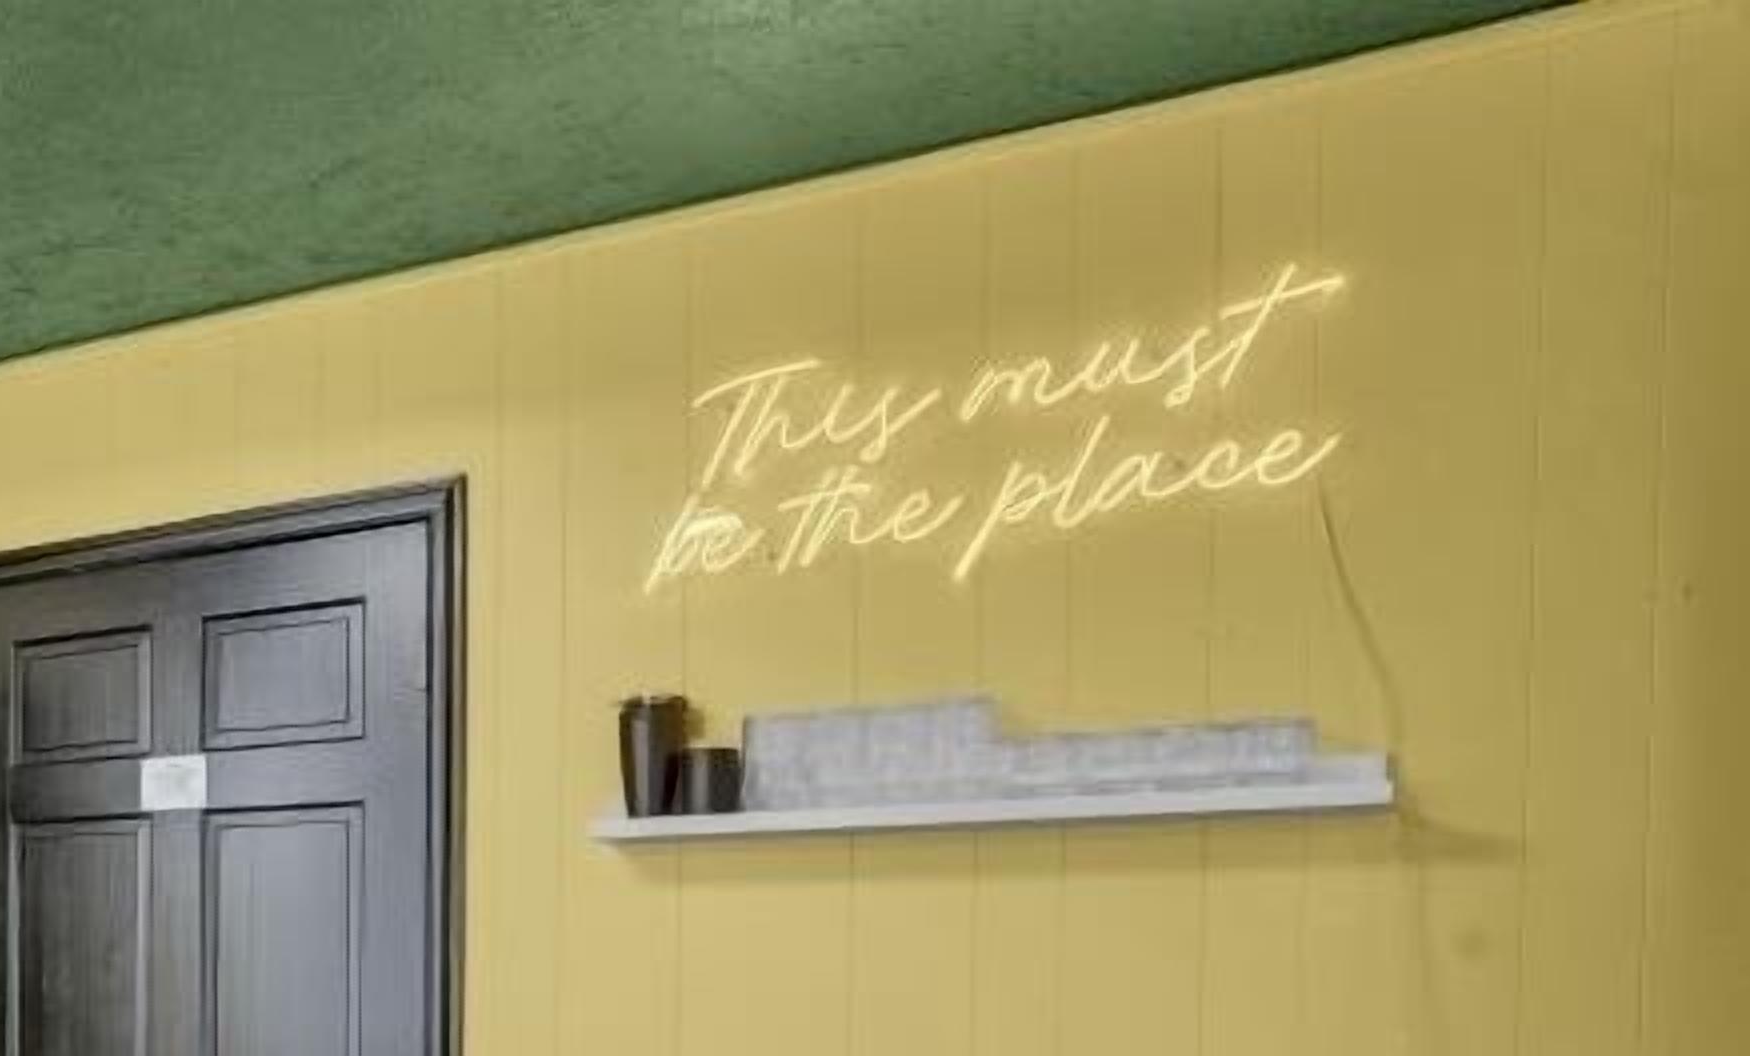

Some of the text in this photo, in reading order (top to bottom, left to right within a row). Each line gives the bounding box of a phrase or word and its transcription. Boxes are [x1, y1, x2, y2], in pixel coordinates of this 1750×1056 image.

[691, 261, 1348, 489] This must
[644, 414, 1343, 596] be the place
